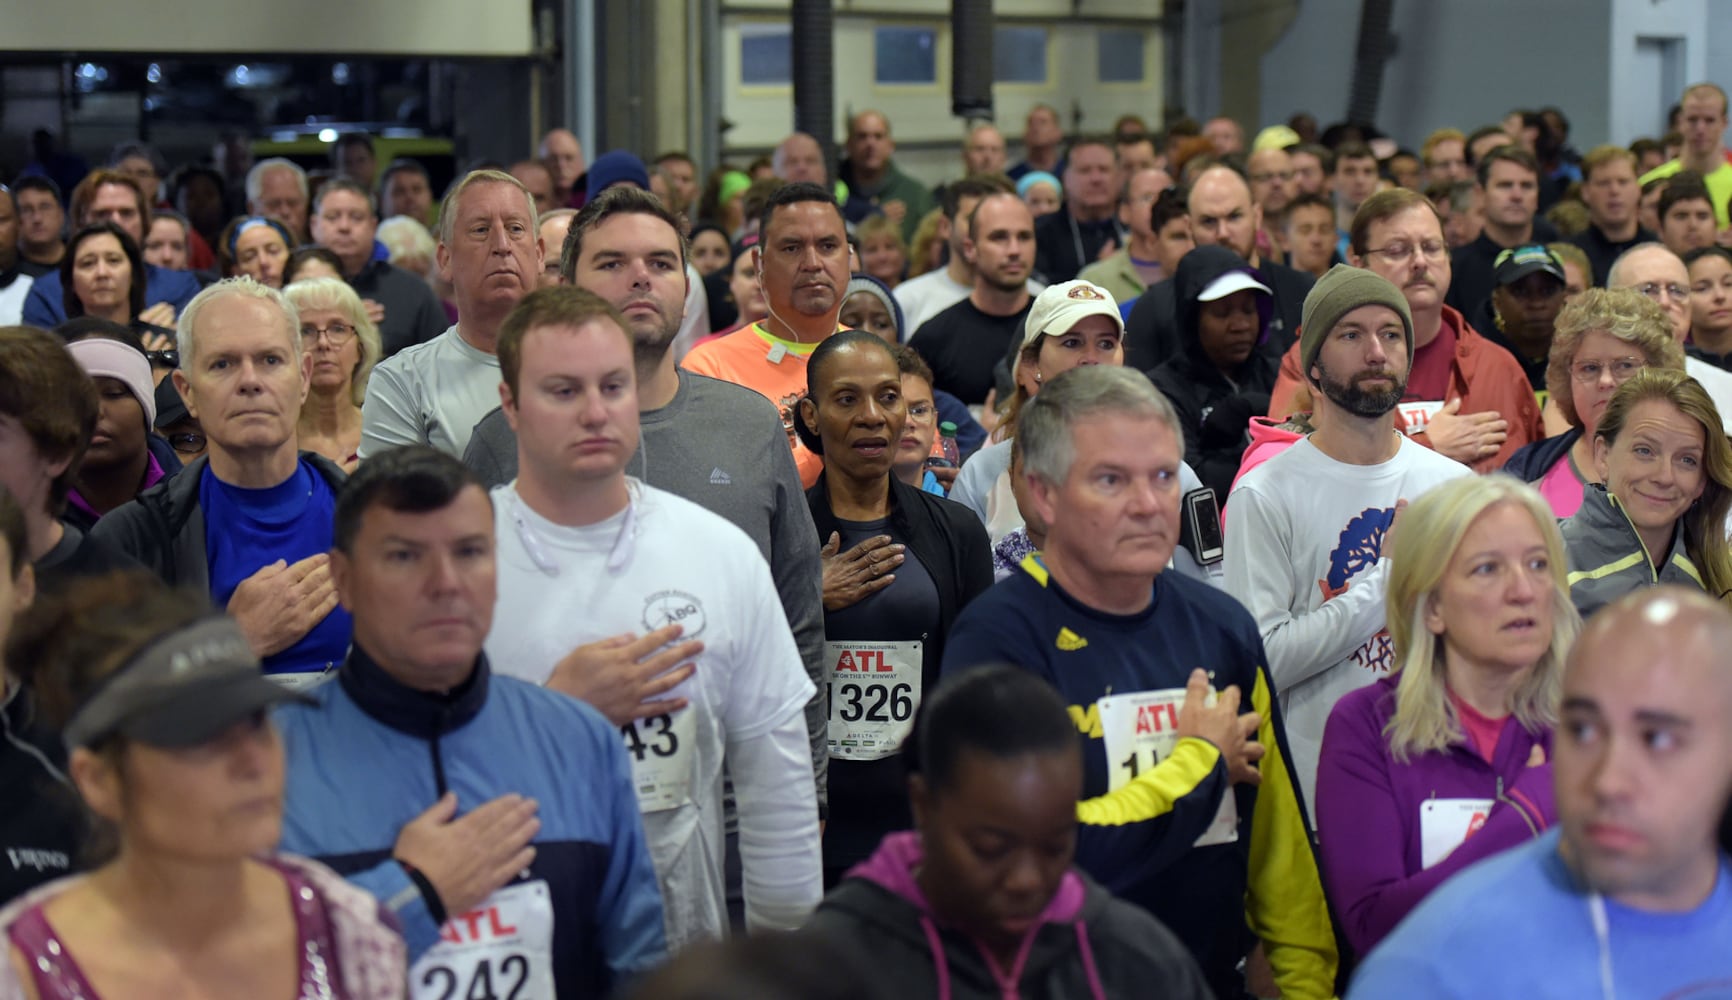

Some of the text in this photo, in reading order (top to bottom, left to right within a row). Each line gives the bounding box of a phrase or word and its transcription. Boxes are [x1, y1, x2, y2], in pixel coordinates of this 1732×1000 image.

[665, 604, 697, 625] ABQ
[835, 650, 893, 672] ATL
[827, 682, 912, 722] 1326
